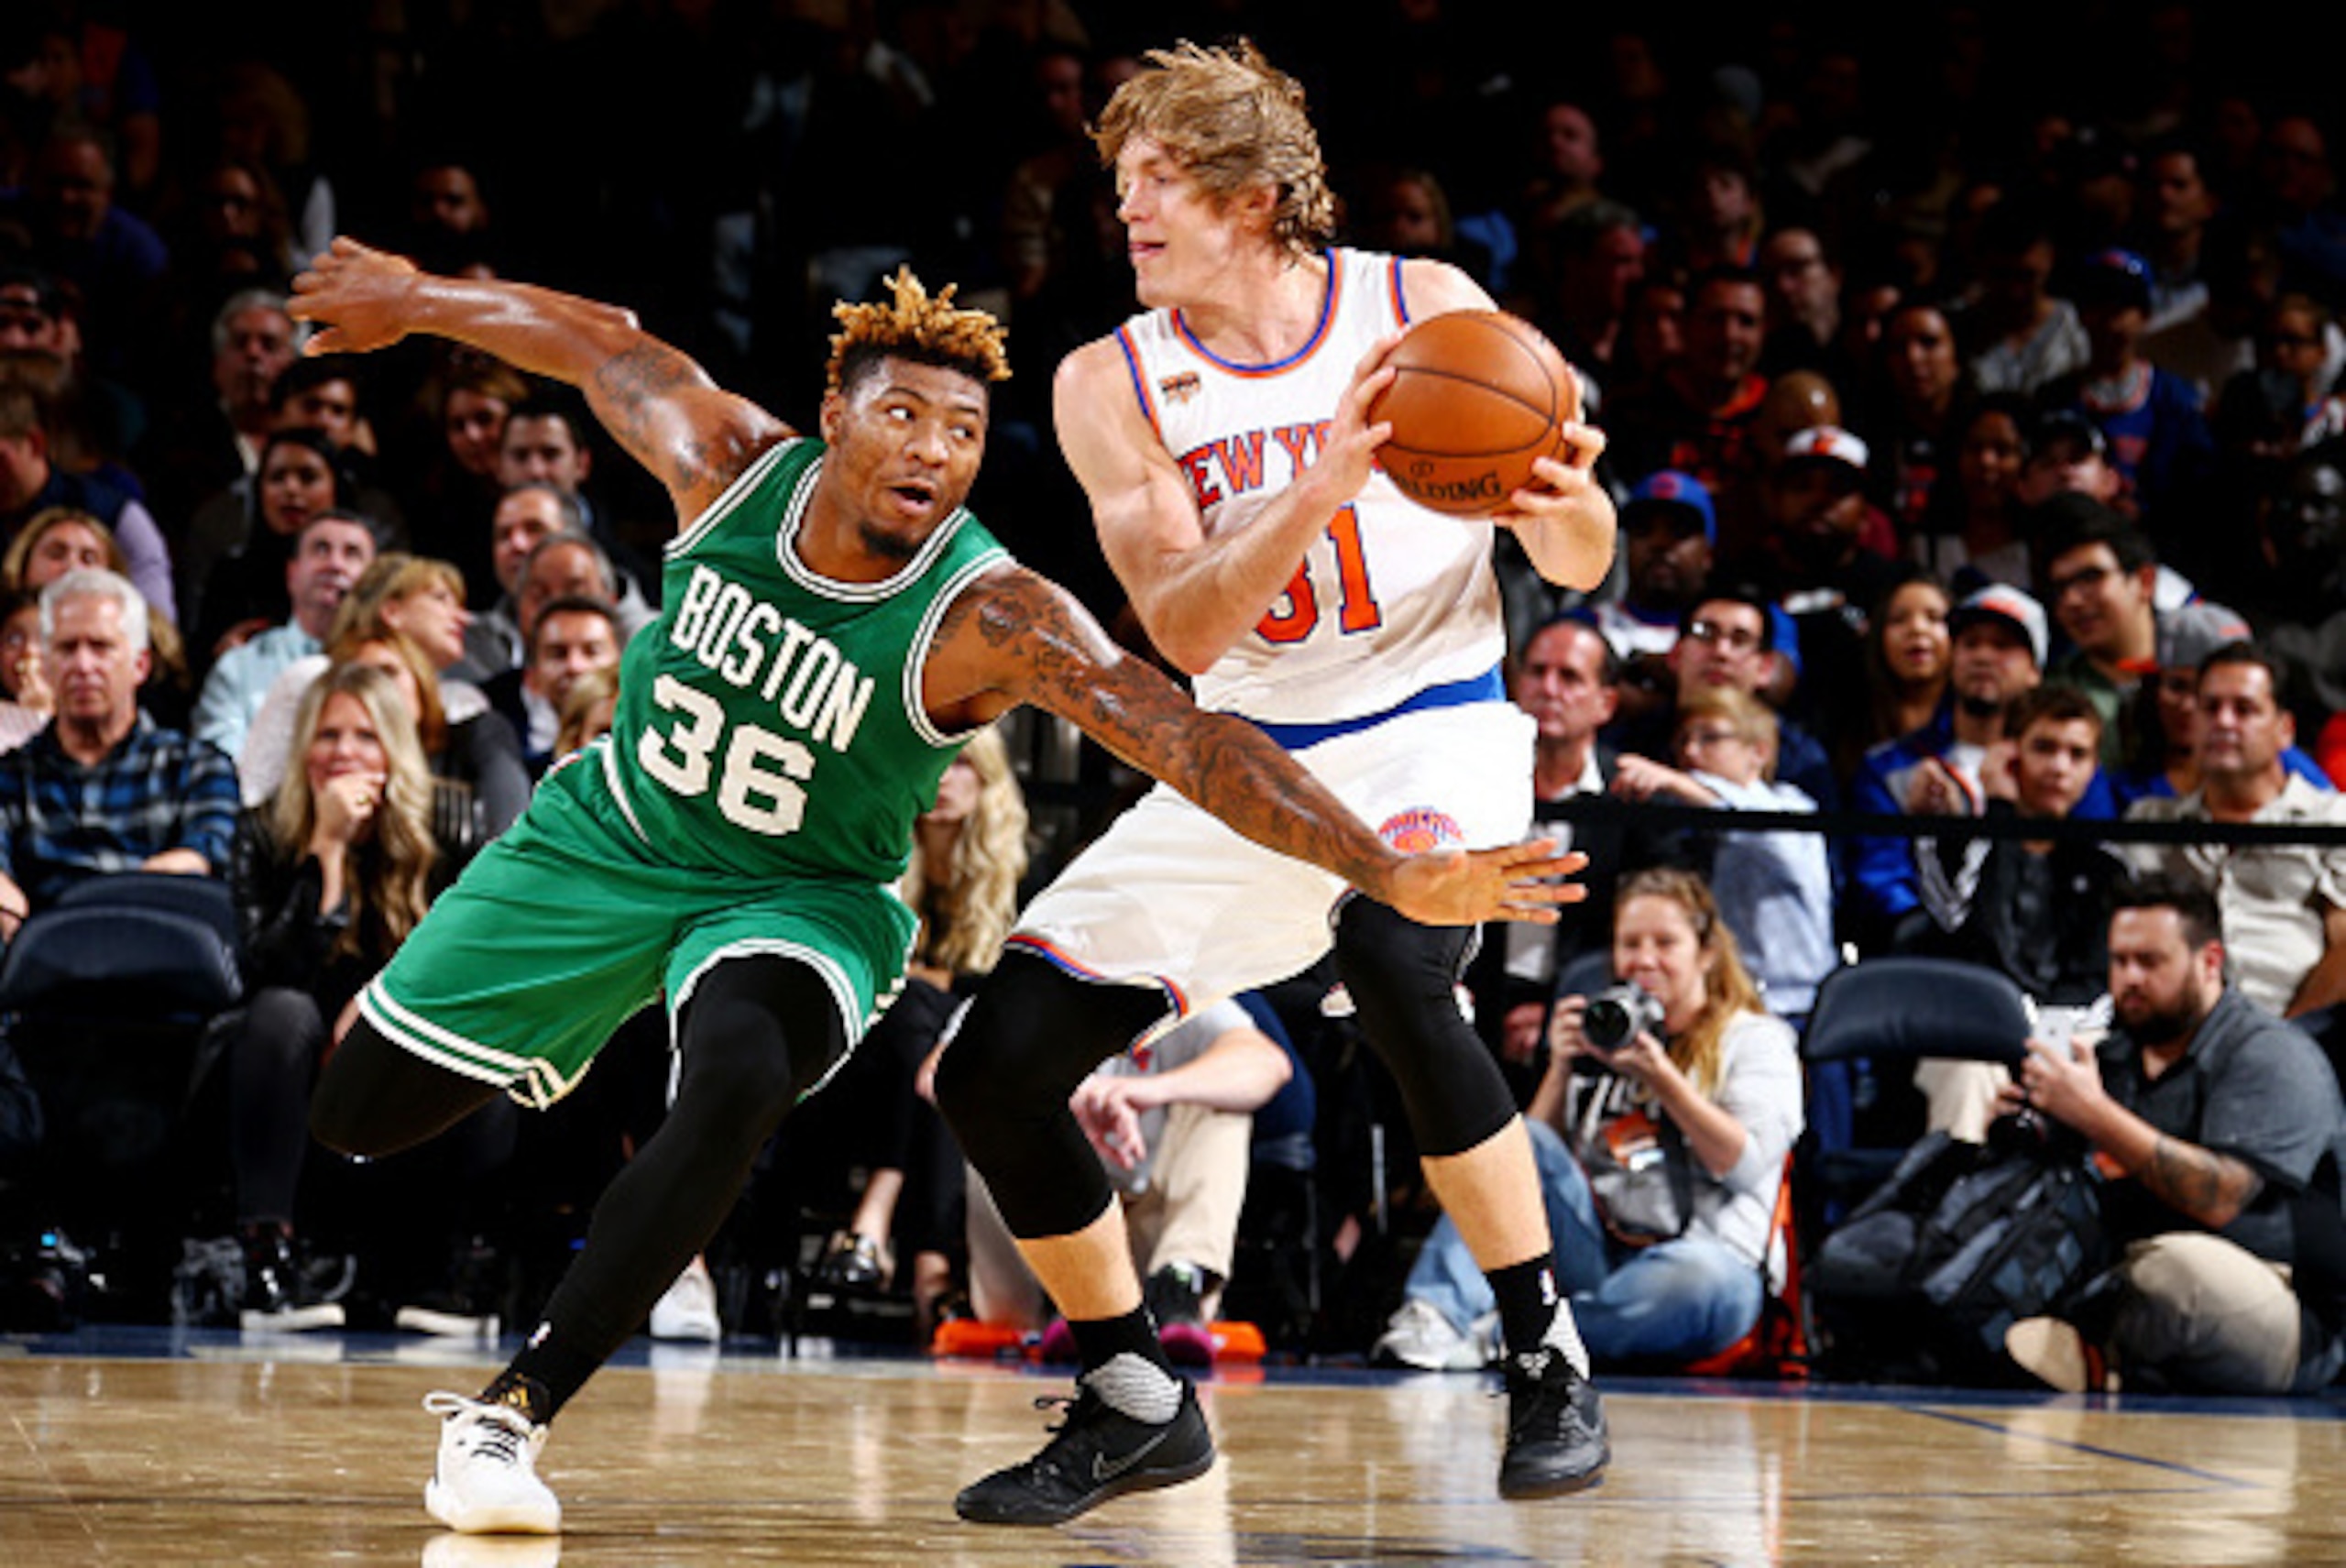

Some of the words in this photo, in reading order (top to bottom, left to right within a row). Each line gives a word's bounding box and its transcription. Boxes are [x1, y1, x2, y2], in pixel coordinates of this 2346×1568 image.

[1174, 429, 1265, 512] EW
[669, 563, 875, 753] BOSTON
[637, 673, 817, 836] 36
